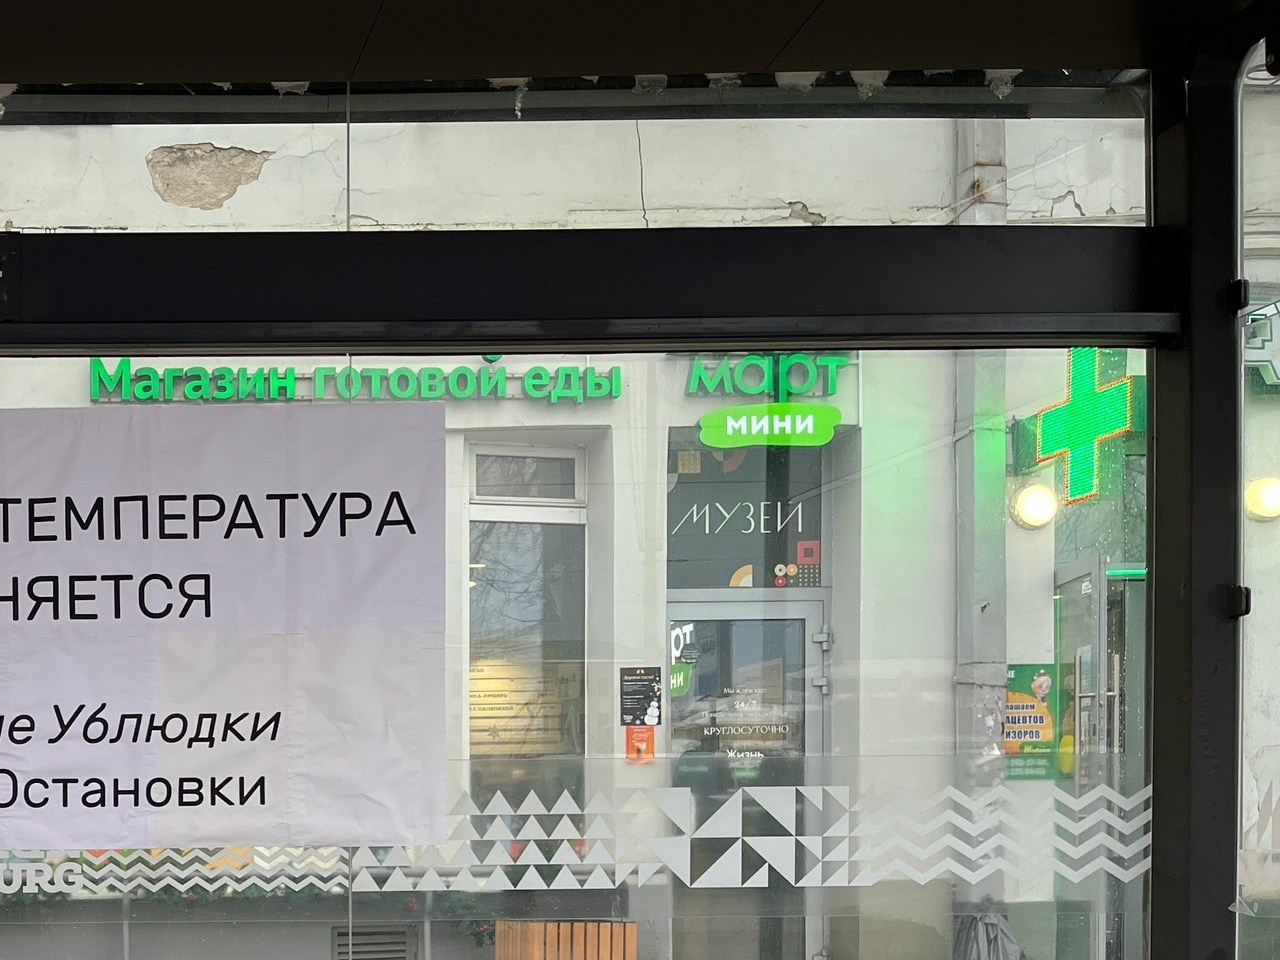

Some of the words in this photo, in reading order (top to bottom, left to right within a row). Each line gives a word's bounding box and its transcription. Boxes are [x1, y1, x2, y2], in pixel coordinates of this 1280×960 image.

[89, 356, 296, 403] Магазин
[314, 355, 508, 401] готовой
[523, 365, 622, 405] еды
[47, 702, 282, 749] Ублюдки
[704, 724, 789, 736] КРУГЛОСУТОЧНО
